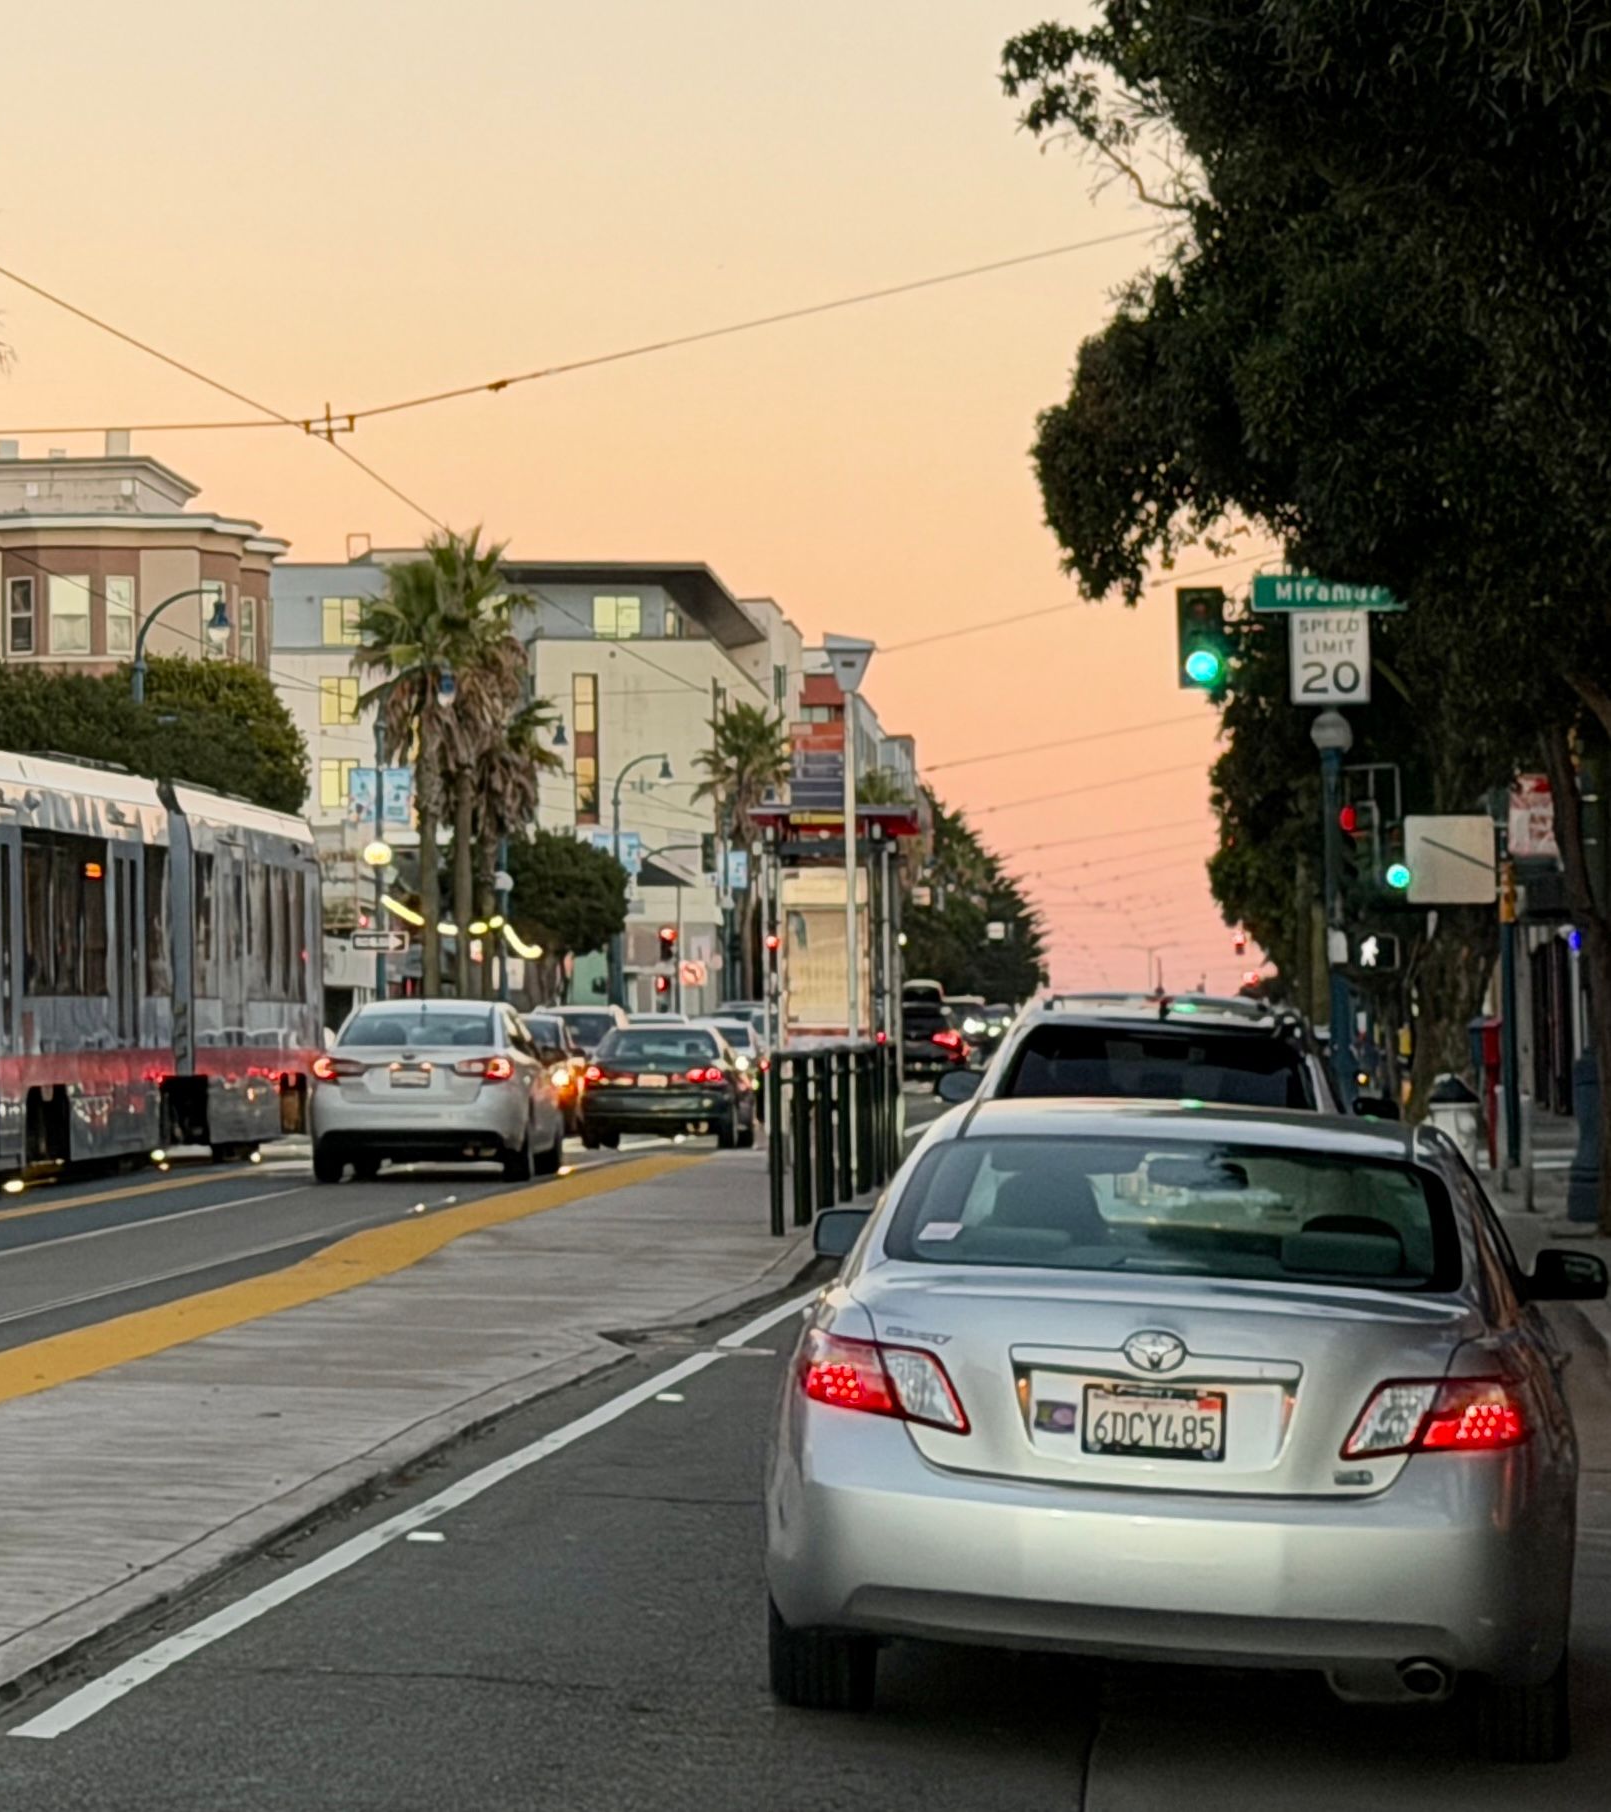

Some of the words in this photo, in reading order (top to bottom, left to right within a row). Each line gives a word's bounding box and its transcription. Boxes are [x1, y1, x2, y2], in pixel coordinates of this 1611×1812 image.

[1299, 618, 1360, 634] SPEED
[1303, 639, 1356, 654] LIMIT
[1301, 660, 1361, 694] 20
[1094, 1410, 1216, 1450] 6DCY485
